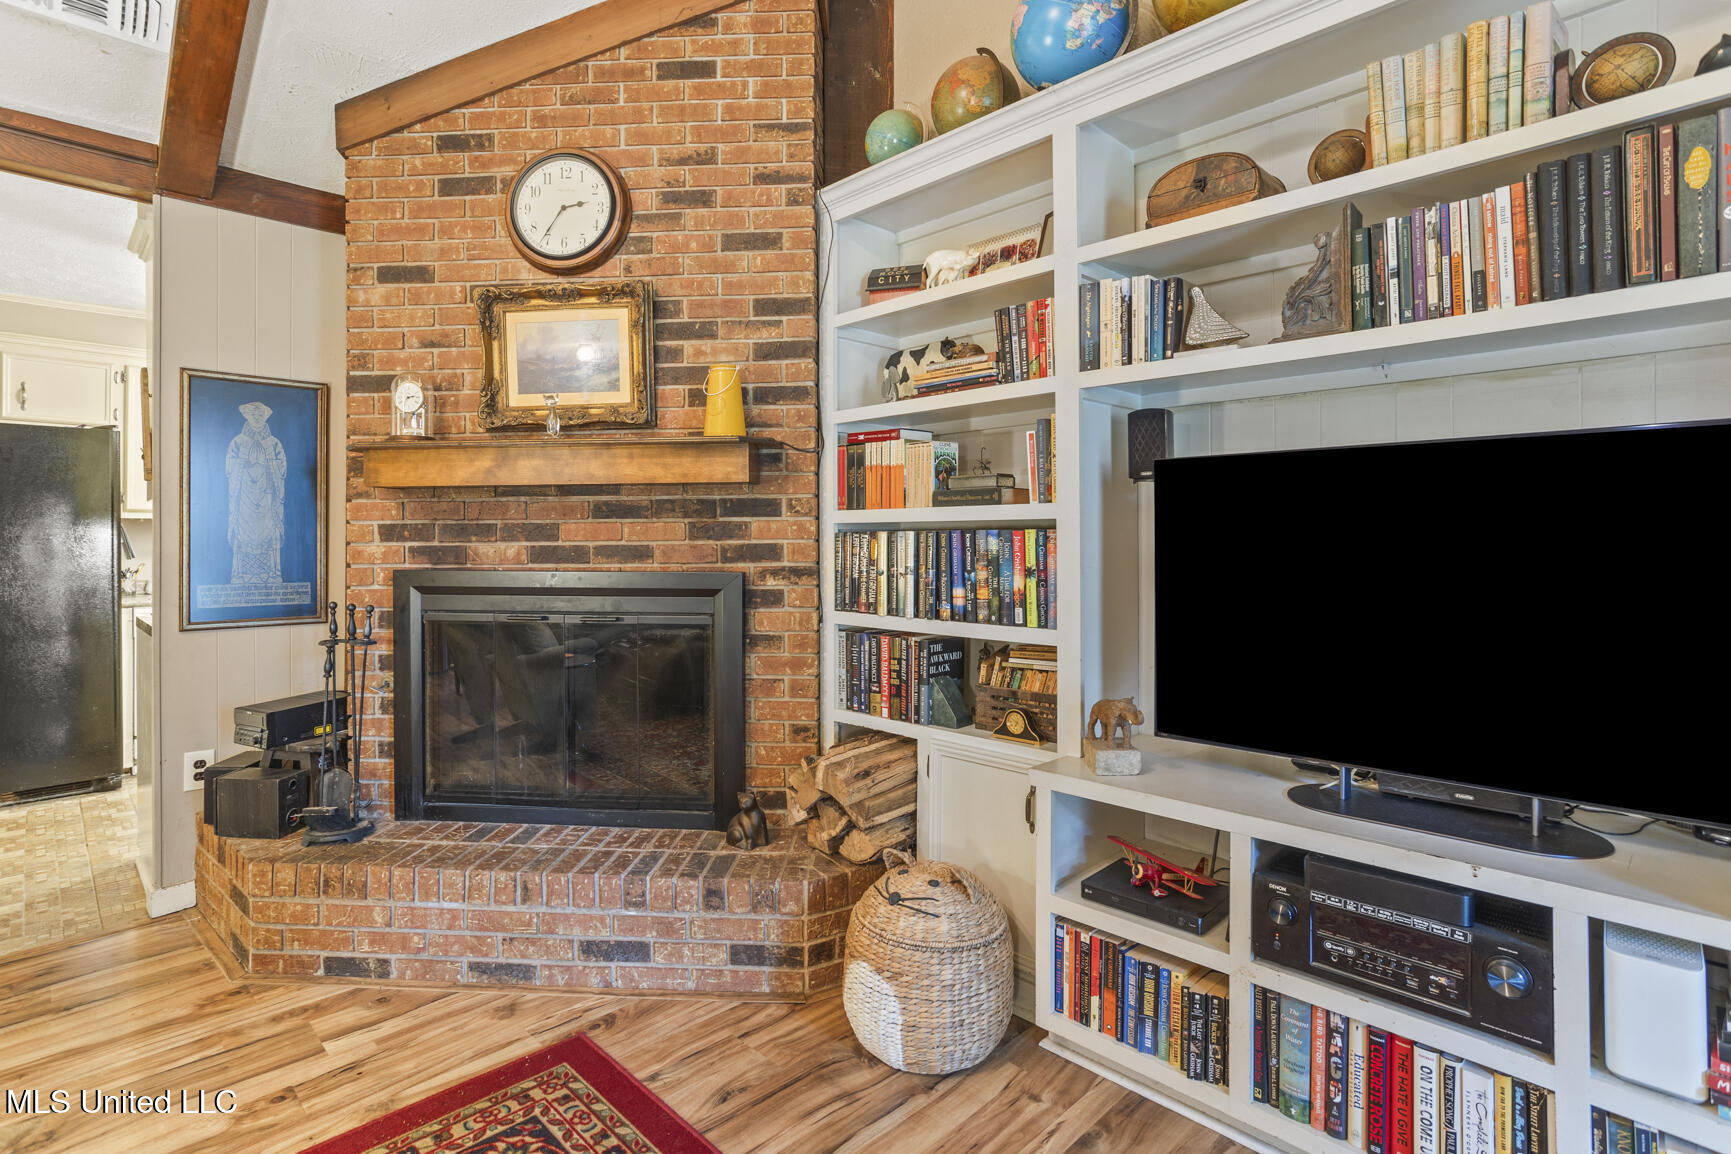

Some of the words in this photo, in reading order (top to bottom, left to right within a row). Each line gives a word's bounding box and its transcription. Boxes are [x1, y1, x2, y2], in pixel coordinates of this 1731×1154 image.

[543, 172, 552, 184] 11
[560, 167, 572, 179] 12
[580, 170, 584, 182] 1
[530, 186, 541, 198] 10
[592, 183, 598, 195] 2
[524, 202, 531, 215] 9
[597, 201, 604, 214] 3
[1500, 206, 1509, 224] maid
[530, 221, 538, 233] 8
[593, 220, 599, 232] 4
[561, 236, 568, 248] 6
[579, 233, 586, 247] 5
[878, 275, 910, 284] CITY
[930, 644, 943, 652] THE
[930, 651, 962, 664] AWKWARD
[930, 664, 950, 674] BLACK
[1268, 883, 1286, 892] DENON
[1143, 978, 1155, 992] JOHN
[1143, 992, 1155, 1016] GRISHAM
[1289, 1008, 1300, 1016] The
[1280, 1013, 1308, 1030] Covenant
[1286, 1033, 1302, 1047] Water
[1397, 1052, 1409, 1074] THE
[1353, 1052, 1365, 1110] Educated
[1369, 1044, 1384, 1104] CONCRETE
[1420, 1066, 1433, 1084] ON
[1397, 1075, 1408, 1106] HATE
[1445, 1067, 1455, 1100] PROPHET
[1420, 1087, 1433, 1108] THE
[1529, 1090, 1540, 1104] THE
[1397, 1107, 1408, 1117] U
[1445, 1100, 1453, 1122] SONG
[1530, 1104, 1540, 1128] STREET
[1369, 1103, 1383, 1145] ROSE
[1420, 1110, 1433, 1144] COME
[1472, 1102, 1489, 1145] Complete
[1397, 1118, 1408, 1147] GIVE
[1447, 1132, 1457, 1148] PAUL
[1530, 1127, 1540, 1153] LAWYER
